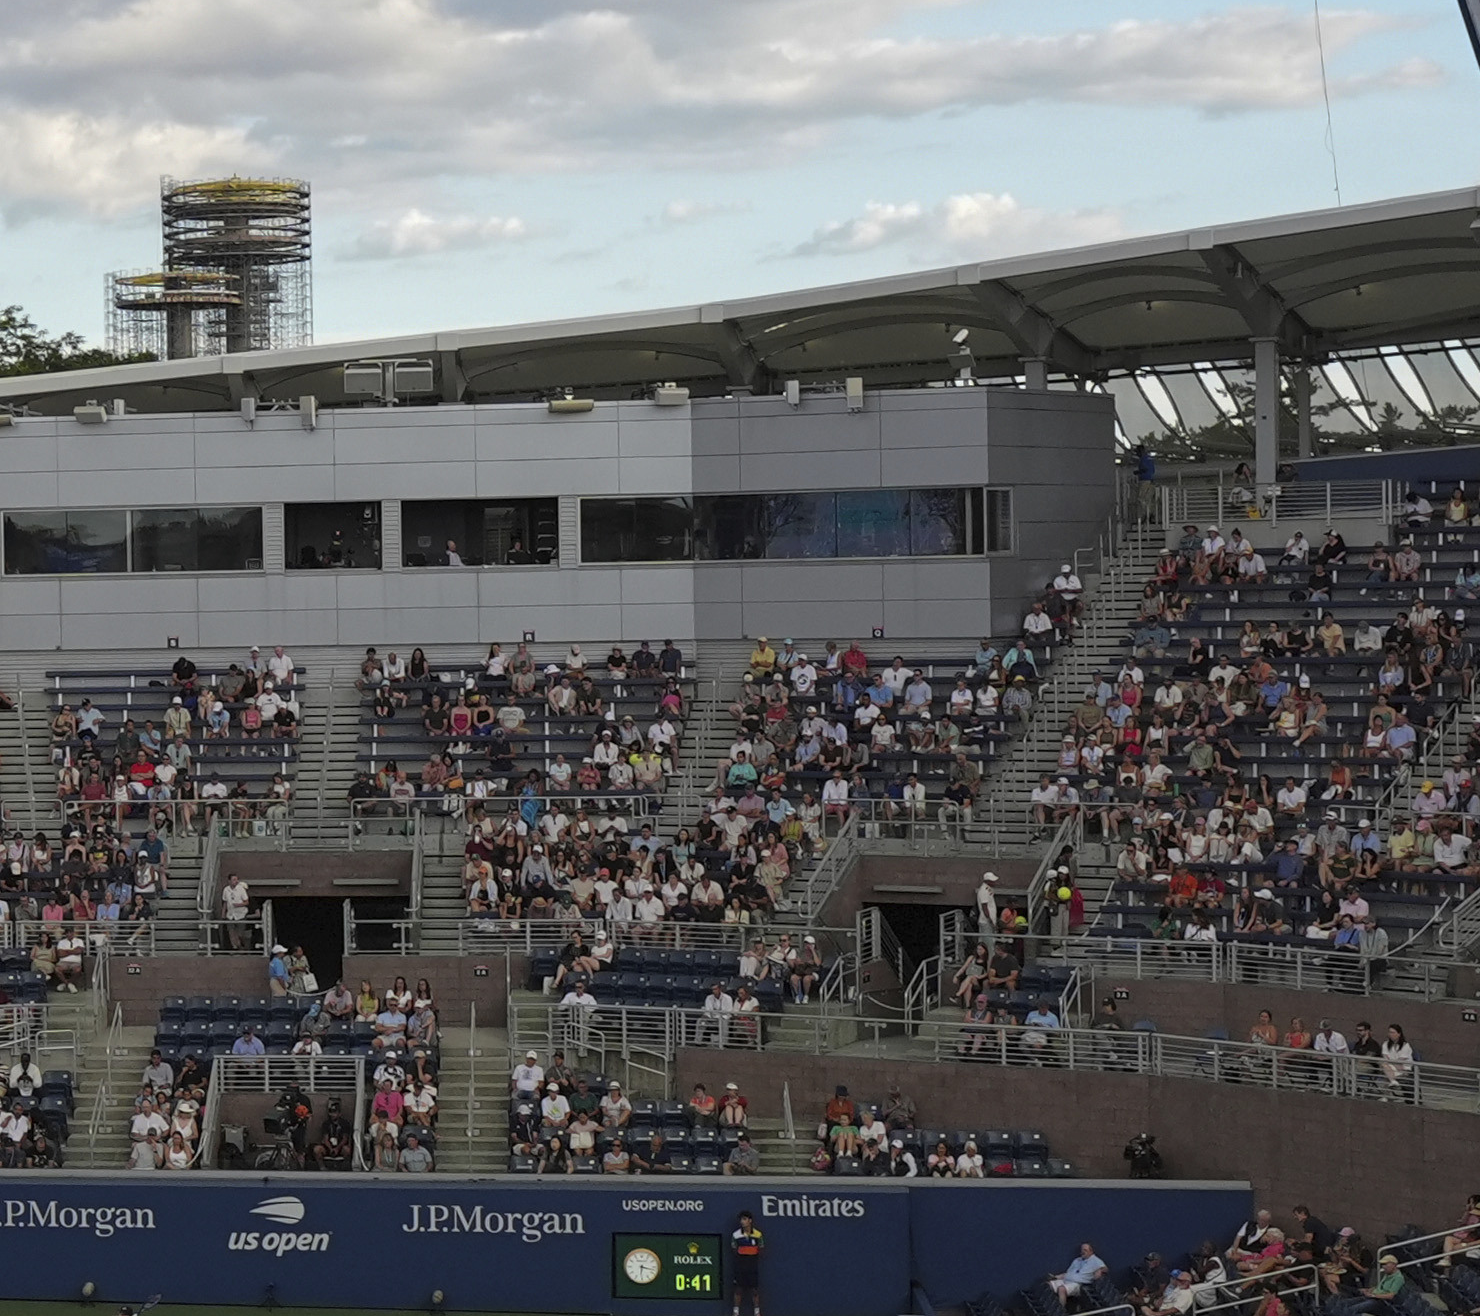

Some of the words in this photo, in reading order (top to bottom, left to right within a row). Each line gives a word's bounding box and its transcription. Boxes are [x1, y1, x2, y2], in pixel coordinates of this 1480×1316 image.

[621, 1199, 705, 1212] USOPEN.ORG
[761, 1195, 865, 1218] Emirates
[402, 1204, 586, 1242] J.P.Morgan
[228, 1232, 259, 1251] us
[265, 1232, 330, 1257] open
[673, 1255, 713, 1265] ROLEX
[675, 1274, 711, 1292] 0:41
